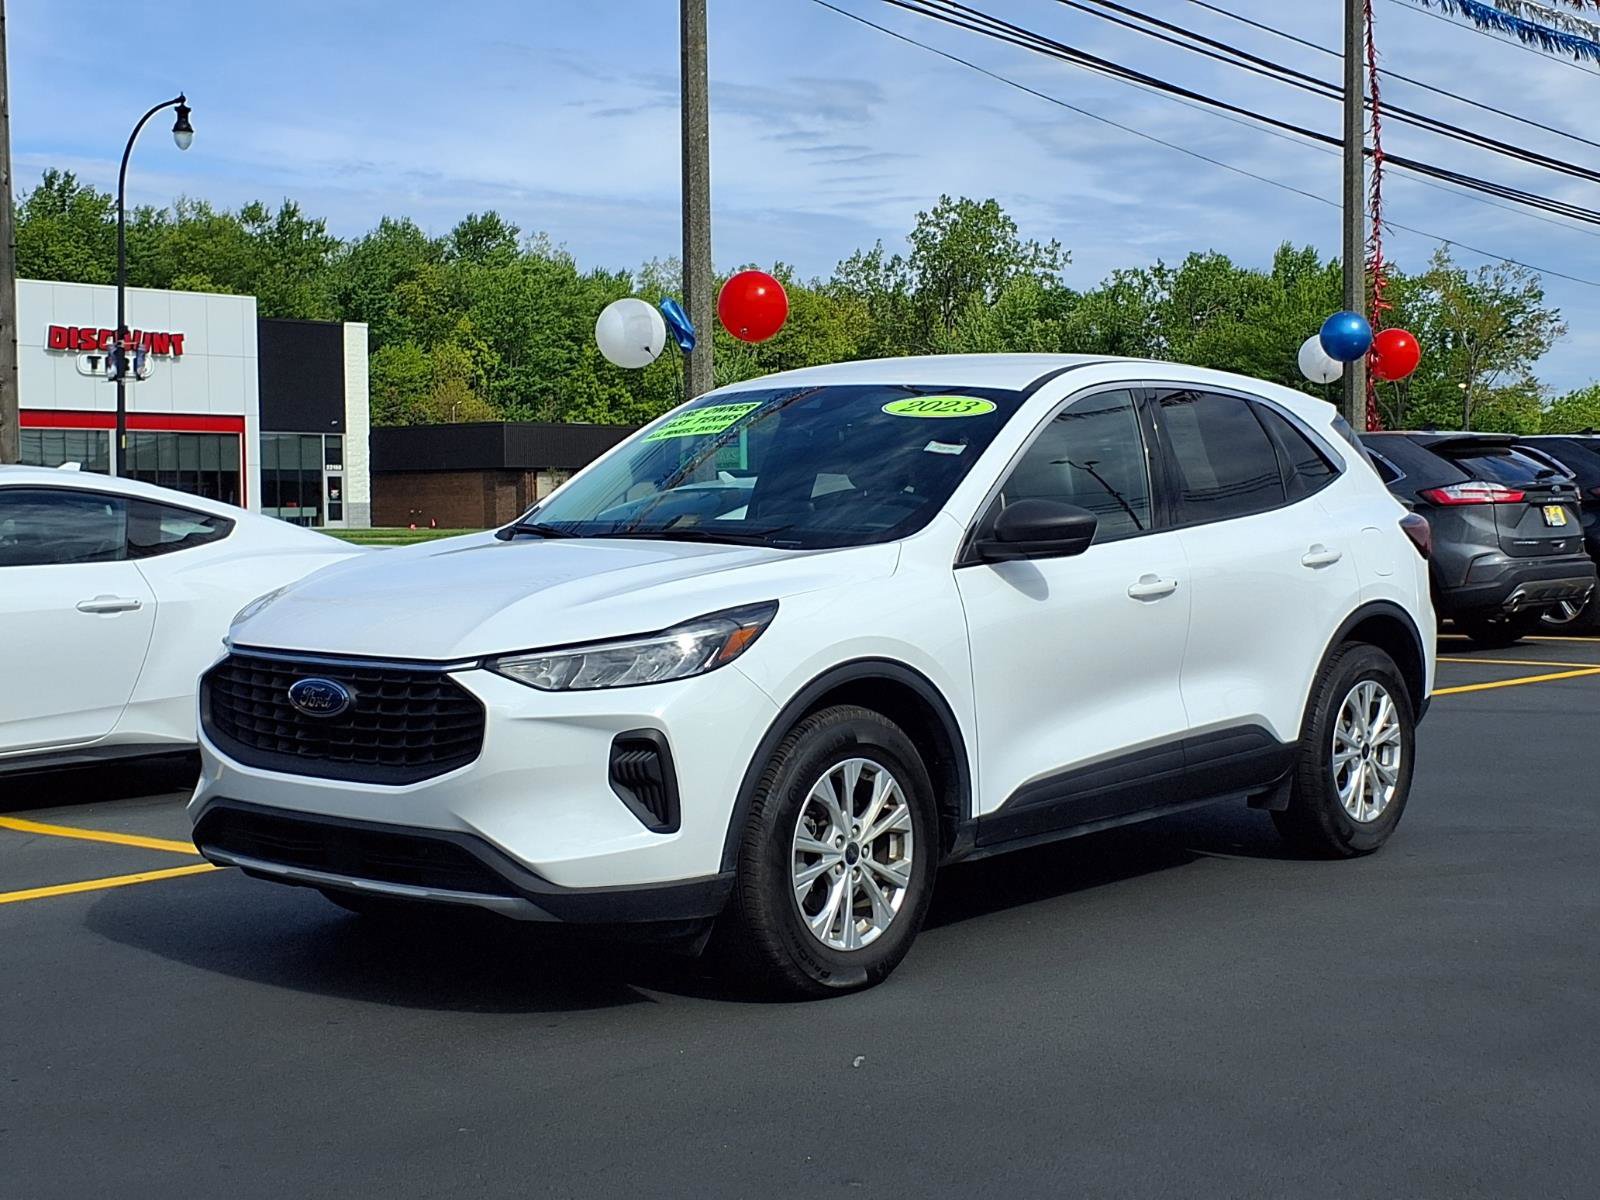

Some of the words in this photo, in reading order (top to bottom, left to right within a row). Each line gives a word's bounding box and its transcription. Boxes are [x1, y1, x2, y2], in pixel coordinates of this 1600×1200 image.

[49, 325, 185, 356] DISCUNT
[898, 400, 980, 413] 2023
[300, 686, 333, 709] Ford
